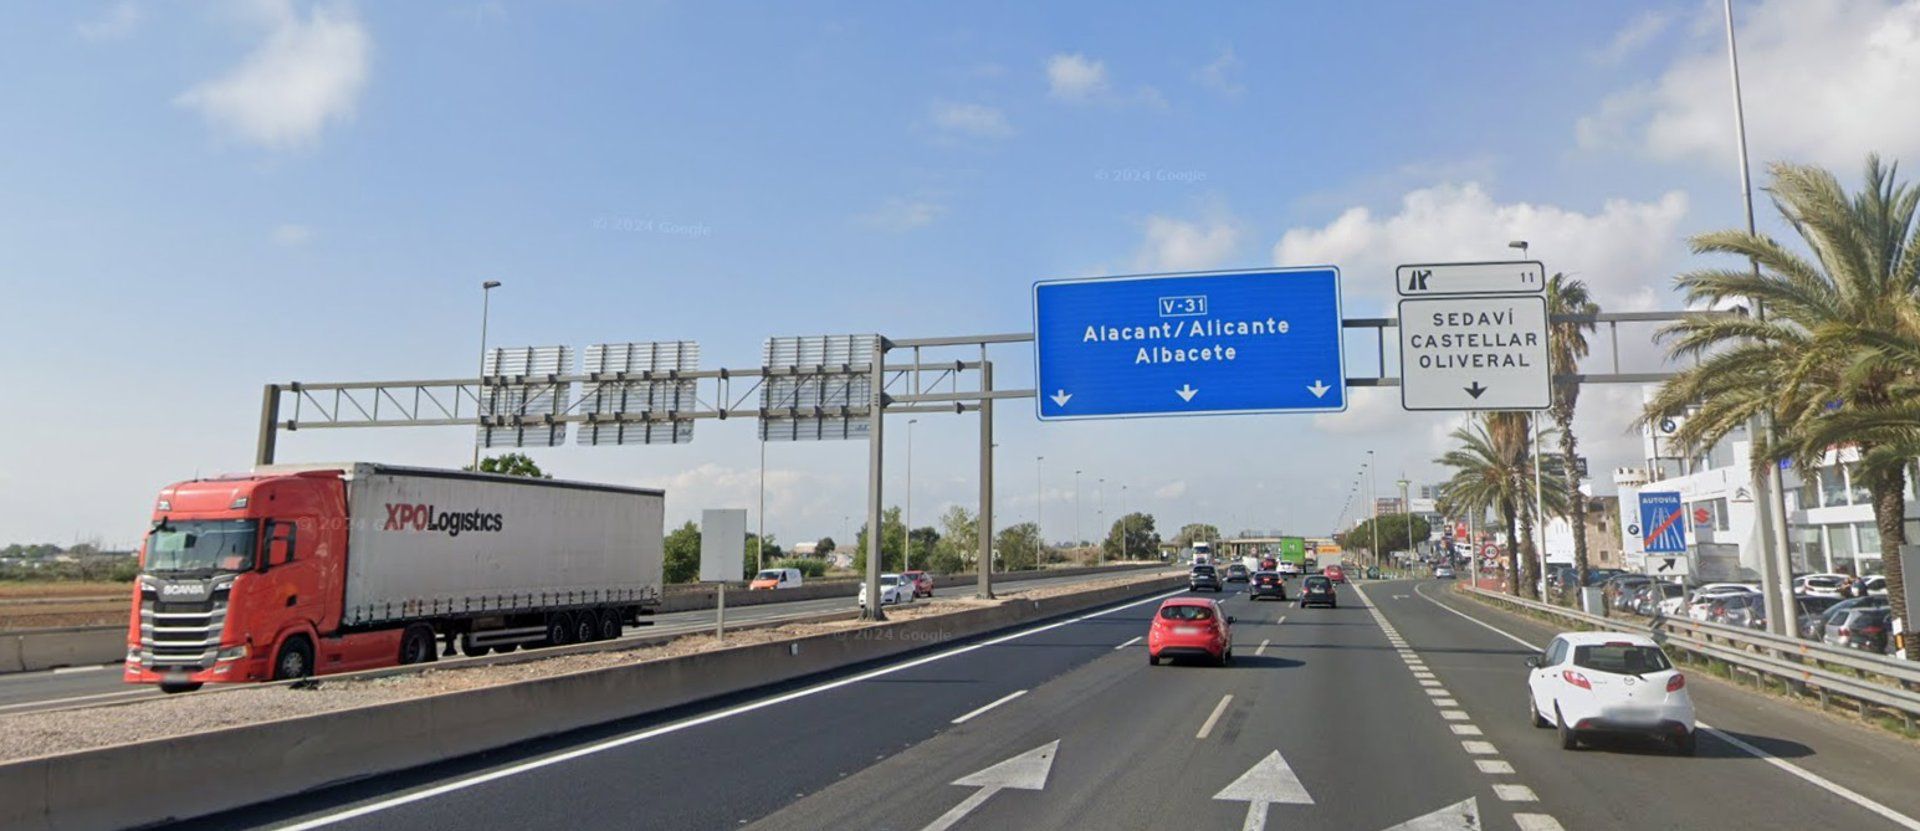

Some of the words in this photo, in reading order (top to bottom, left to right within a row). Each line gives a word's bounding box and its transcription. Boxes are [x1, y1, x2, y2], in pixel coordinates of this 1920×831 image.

[1520, 272, 1535, 283] 11
[1162, 298, 1205, 314] V-31
[1433, 308, 1513, 327] SEDAVÍ
[1083, 318, 1290, 343] Alacant/Alicante
[1411, 333, 1538, 349] CASTELLAR
[1135, 344, 1237, 365] Albacete
[1419, 354, 1531, 369] OLIVERAL
[163, 584, 205, 596] SCANIA
